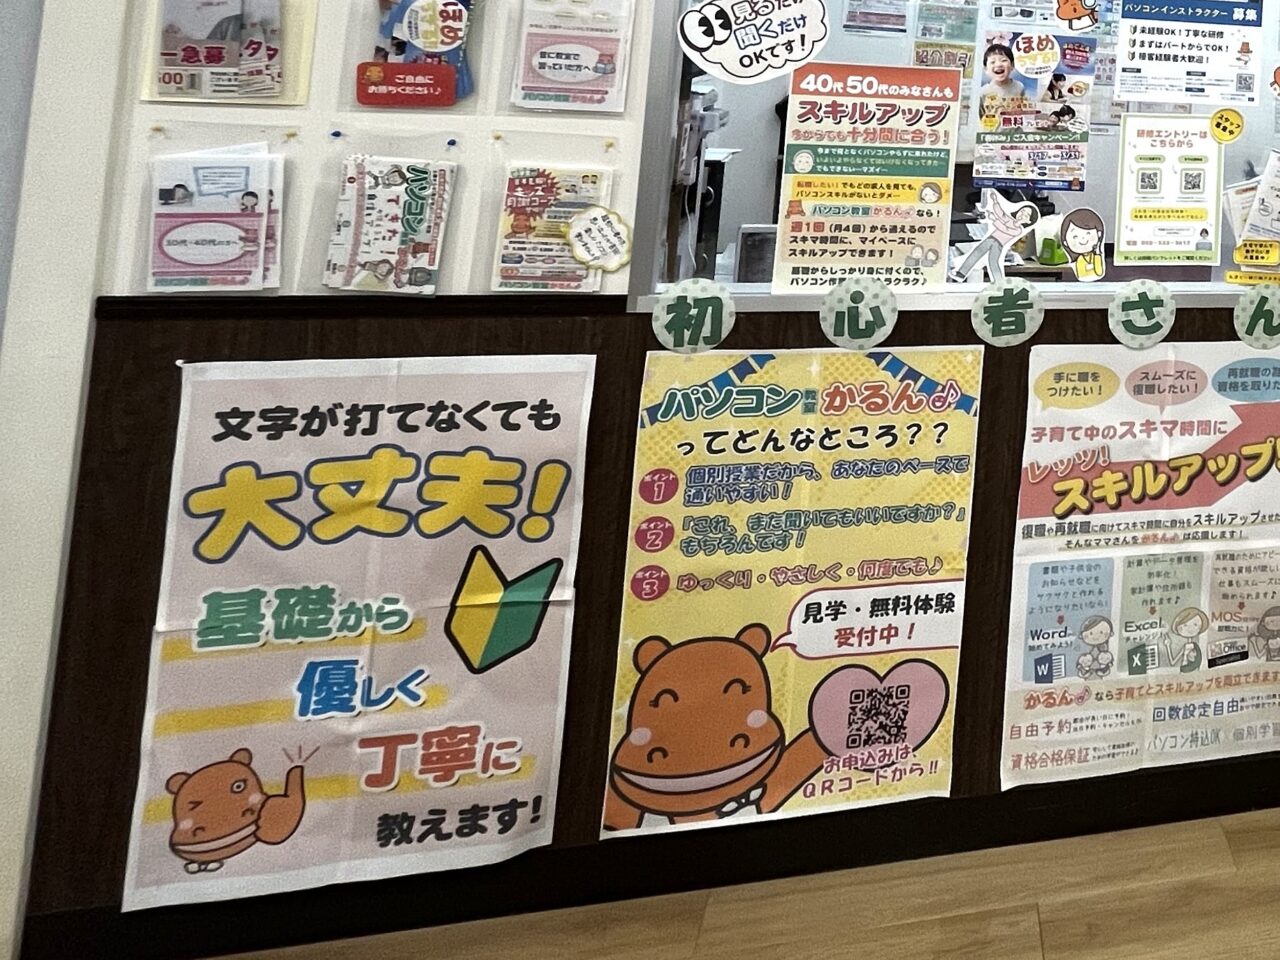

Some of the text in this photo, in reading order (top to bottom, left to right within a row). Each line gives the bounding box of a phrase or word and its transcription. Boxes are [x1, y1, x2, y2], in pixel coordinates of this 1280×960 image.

[1124, 2, 1258, 22] パソコンインストラクター 募集
[734, 14, 808, 49] 聞くだけ
[1016, 35, 1054, 54] ほめ
[796, 100, 950, 126] スキルアップ
[1002, 117, 1023, 127] 無料
[1150, 140, 1194, 148] こちらから
[1053, 371, 1100, 383] 手に職を
[1139, 370, 1196, 381] スムーズに
[656, 387, 803, 422] パソコン
[820, 380, 928, 417] かるん
[212, 398, 561, 443] 文字が打てなくても
[1031, 419, 1227, 444] 子育て中のスキマ時間に
[641, 472, 676, 484] ポイント
[193, 585, 412, 650] 基礎から
[802, 591, 957, 627] 見学・無料体験
[1211, 611, 1242, 623] MOS
[1030, 626, 1068, 640] Word
[1125, 618, 1162, 632] Excel
[293, 658, 428, 720] 優しく
[1152, 698, 1240, 722] 回数設定自由
[1009, 719, 1073, 740] 自由予約
[357, 724, 521, 789] 丁寧に
[1010, 745, 1091, 771] 資格合格保証
